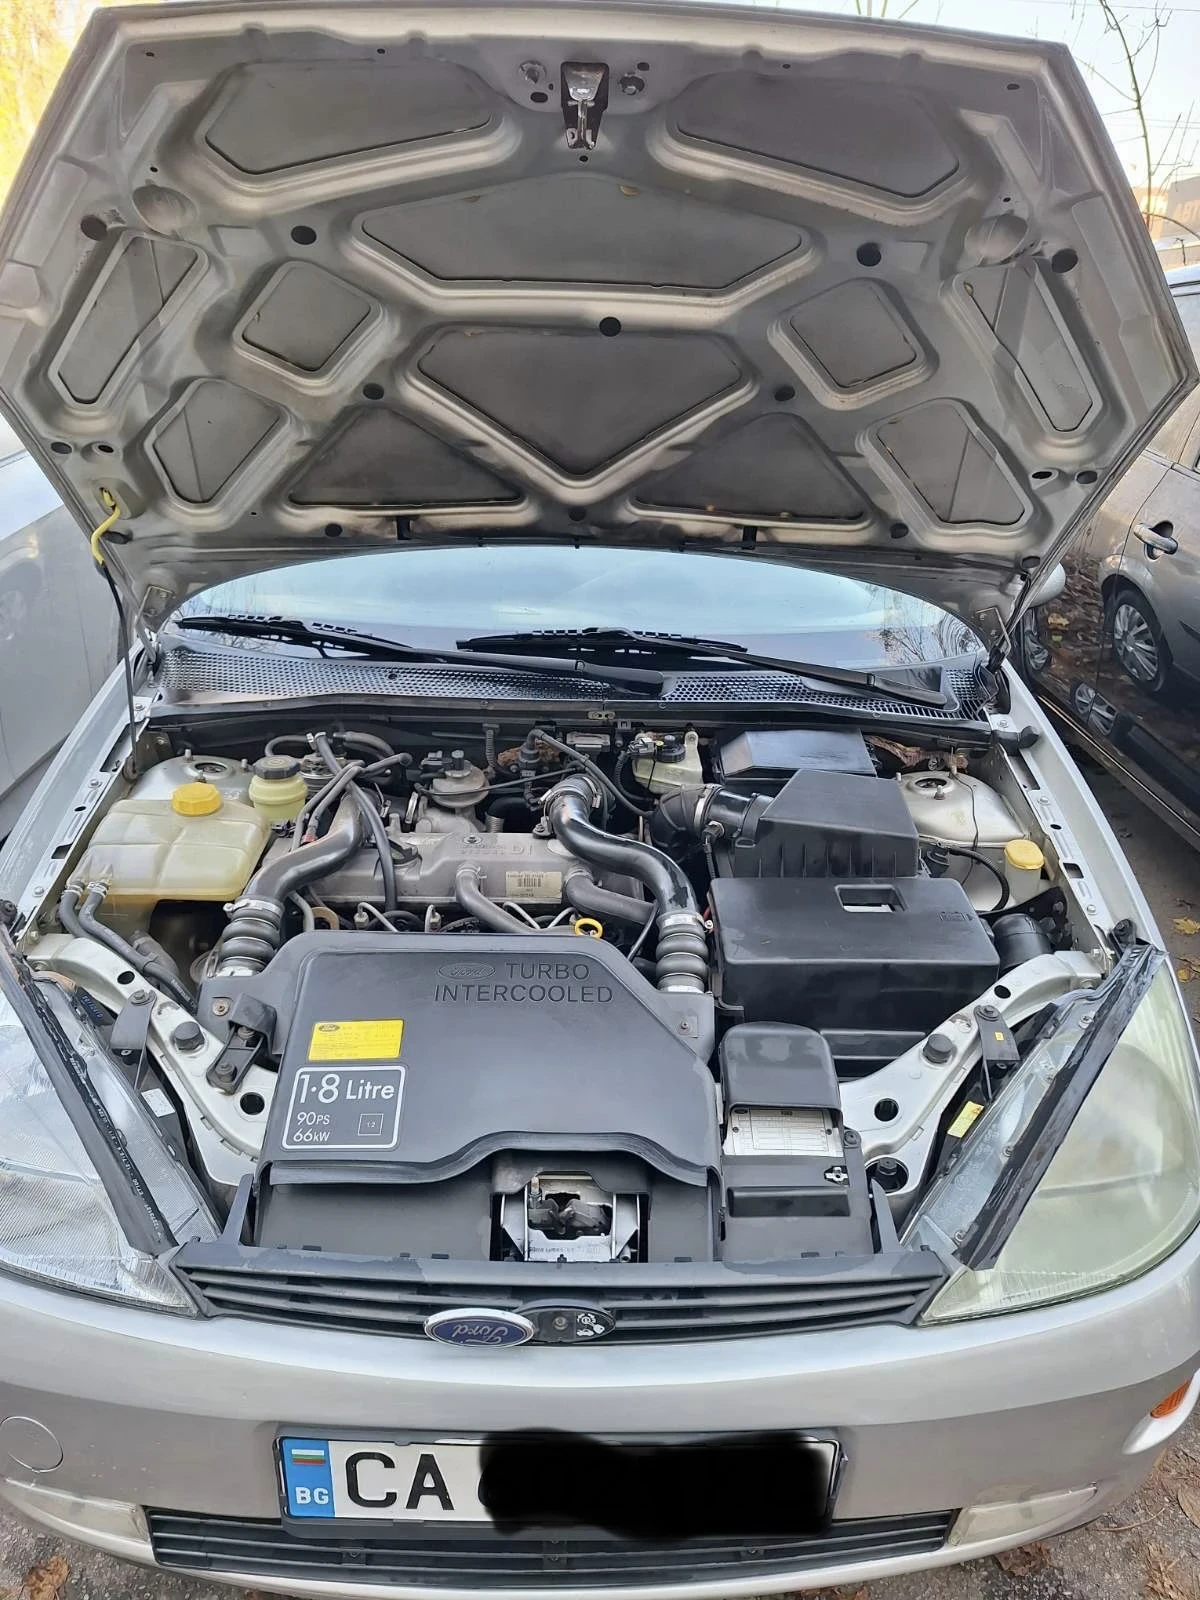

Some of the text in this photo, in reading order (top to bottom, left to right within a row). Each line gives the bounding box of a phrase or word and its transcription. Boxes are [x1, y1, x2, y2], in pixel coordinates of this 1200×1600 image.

[505, 962, 590, 980] TURBO
[434, 984, 613, 1003] INTERCOOLED
[345, 1079, 395, 1100] Litre
[451, 1323, 510, 1346] Ford
[345, 1451, 455, 1511] CA
[295, 1486, 329, 1505] BG
